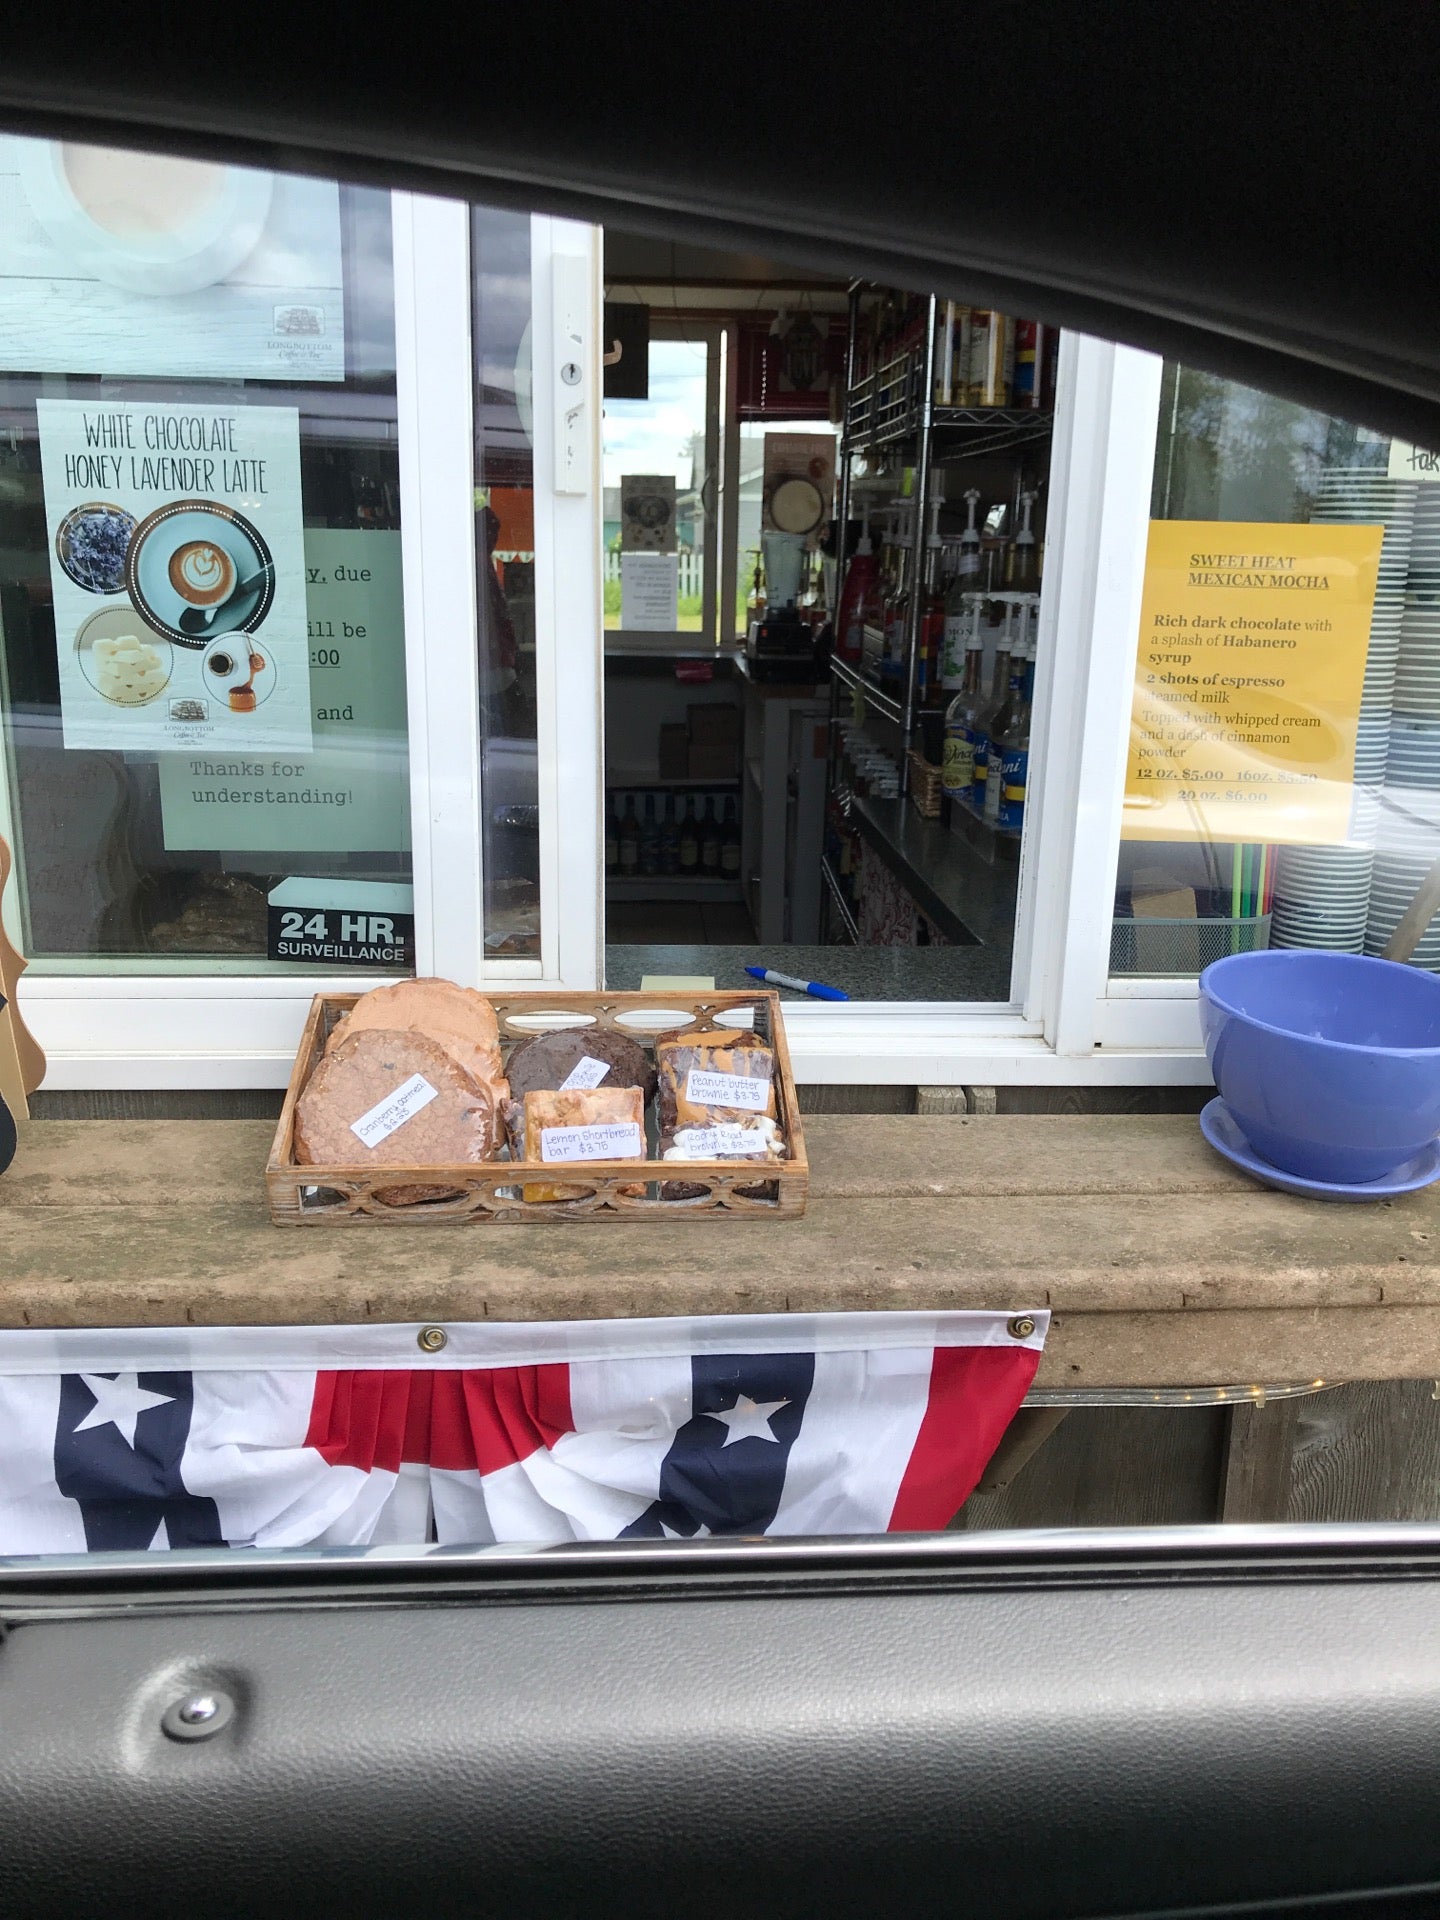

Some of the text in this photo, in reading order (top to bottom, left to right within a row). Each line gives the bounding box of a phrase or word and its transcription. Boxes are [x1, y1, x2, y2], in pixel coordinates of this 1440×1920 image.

[83, 413, 238, 452] WHITE CHOCOLATE
[65, 454, 268, 493] HONEY LAVENDER LATTE
[1190, 554, 1296, 570] SWEET HEAT
[335, 565, 371, 582] due
[1188, 572, 1330, 589] MEXICAN MOCHA
[307, 622, 367, 638] ill be
[1154, 614, 1332, 632] Rich dark chocolate with
[1151, 633, 1297, 649] a splash of Habanero
[1149, 653, 1191, 666] syrup
[1147, 672, 1285, 689] 2 shots of espresso
[1201, 691, 1230, 704] milk
[317, 705, 354, 721] and
[1194, 711, 1221, 724] with
[1225, 712, 1279, 728] whipped
[1282, 717, 1321, 728] cream
[1140, 728, 1290, 744] and a dash of cinnamon
[1138, 747, 1186, 760] powder
[190, 761, 304, 776] Thanks for
[1137, 768, 1152, 778] 12
[1156, 768, 1177, 778] oz.
[1182, 768, 1224, 781] $5.00
[192, 788, 352, 806] understanding!
[1178, 790, 1268, 802] 20 oz. $6.00
[280, 912, 405, 945] 24 HR.
[277, 942, 405, 961] SURVEILLANCE
[691, 1073, 759, 1090] Peanut butter
[691, 1086, 761, 1101] brownie $3.75
[546, 1132, 580, 1145] Lemon
[548, 1146, 570, 1157] bar
